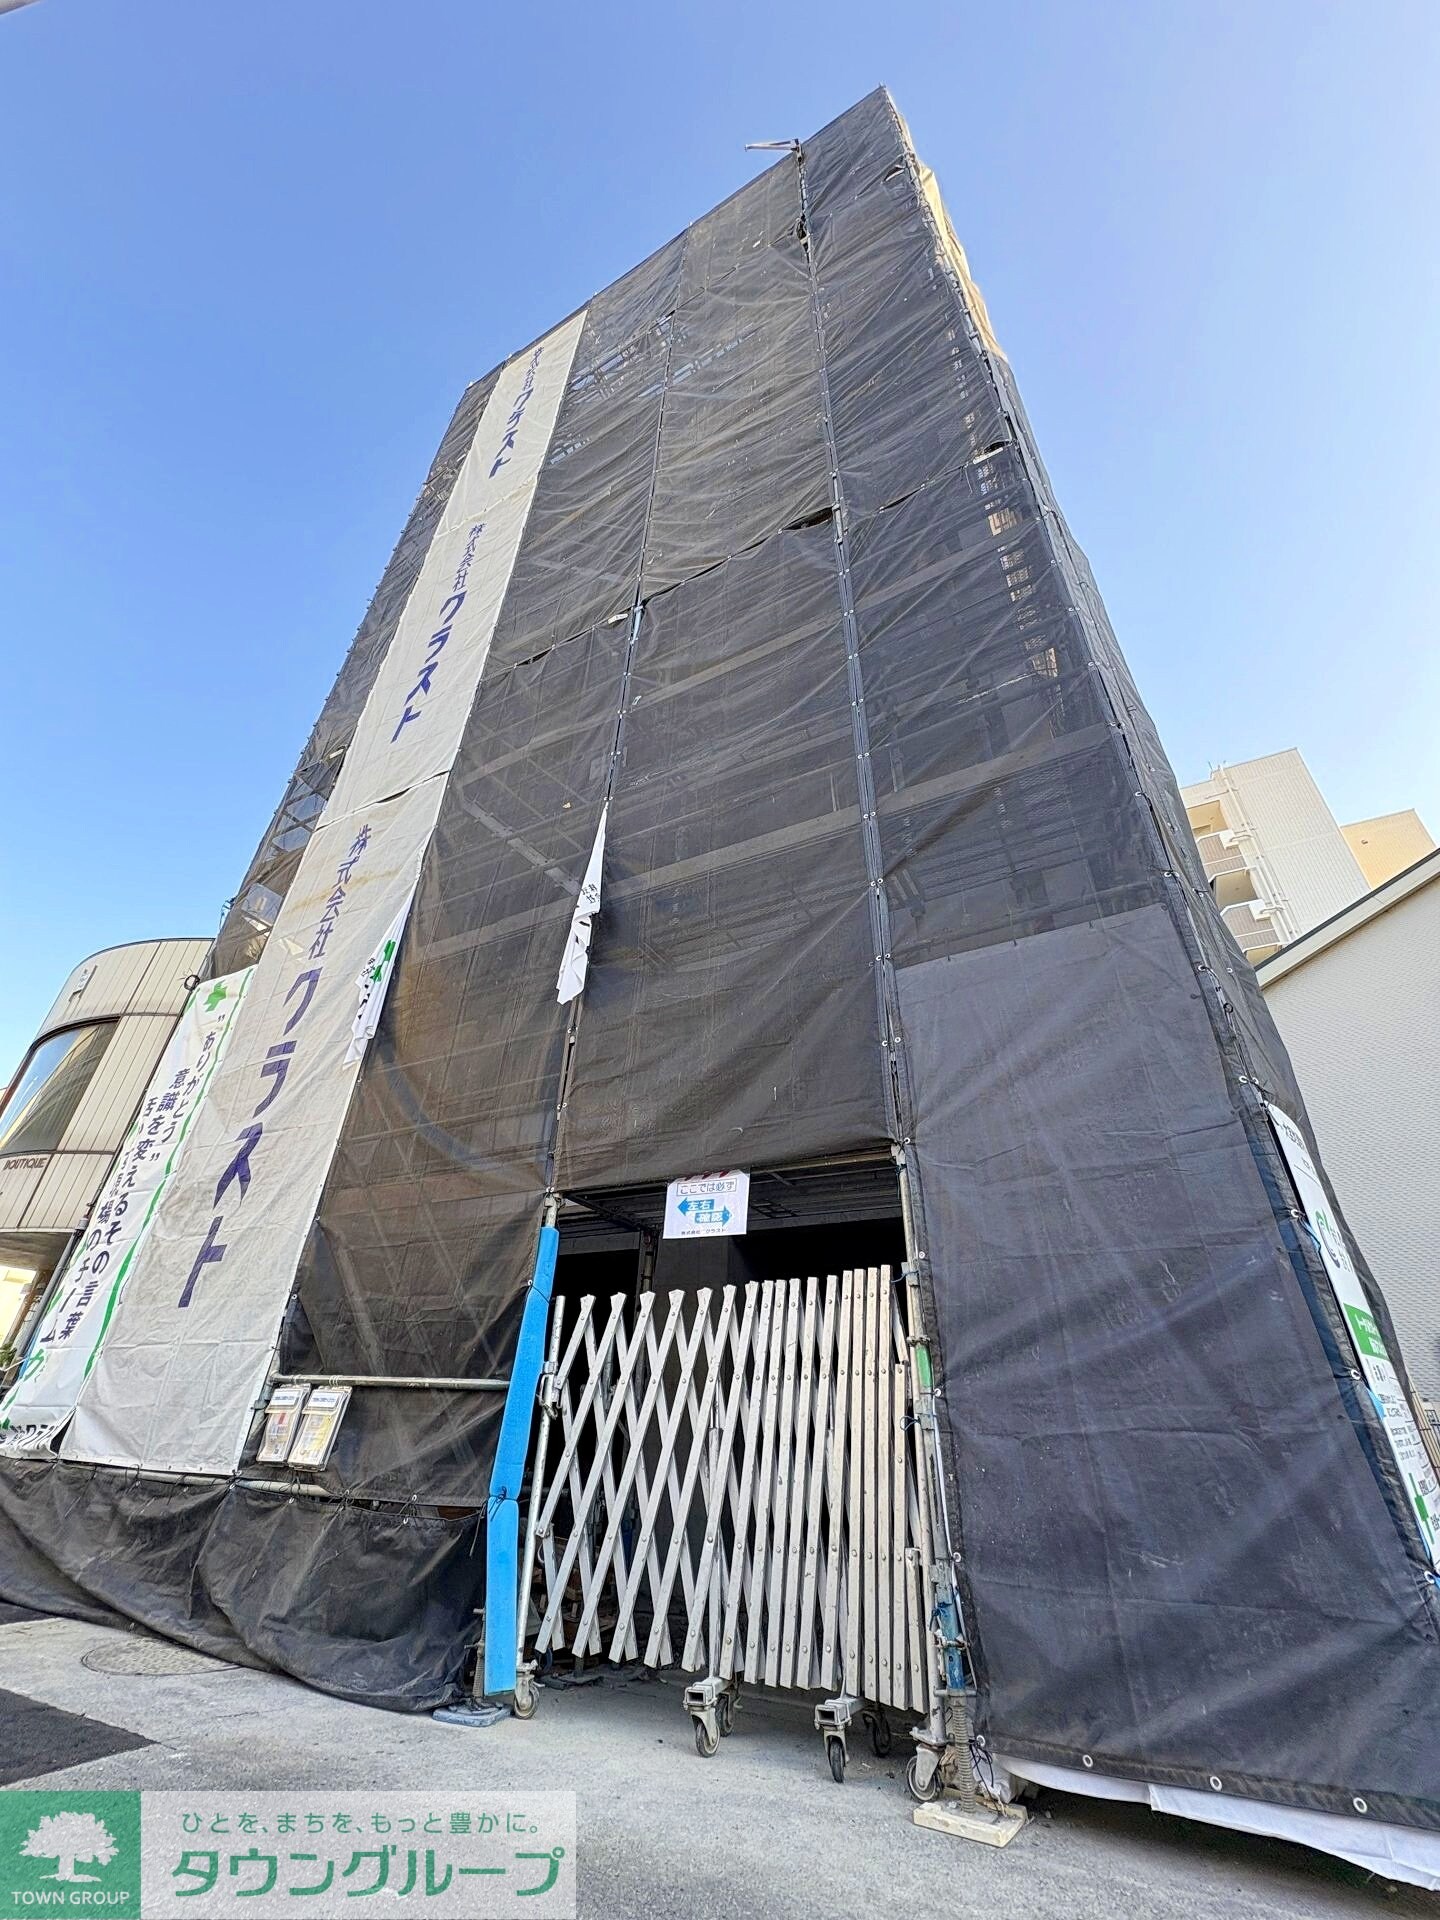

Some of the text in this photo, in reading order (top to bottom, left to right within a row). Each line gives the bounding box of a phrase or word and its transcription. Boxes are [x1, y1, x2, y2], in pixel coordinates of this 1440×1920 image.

[390, 522, 487, 744] 株式会社クラスト
[177, 823, 372, 1309] 株式会社クラスト
[3, 1157, 48, 1170] BOUTIQUE
[58, 1067, 191, 1341] 意識を変えるその言葉
[680, 1181, 735, 1195] ここでは必ず
[688, 1200, 712, 1211] 左右
